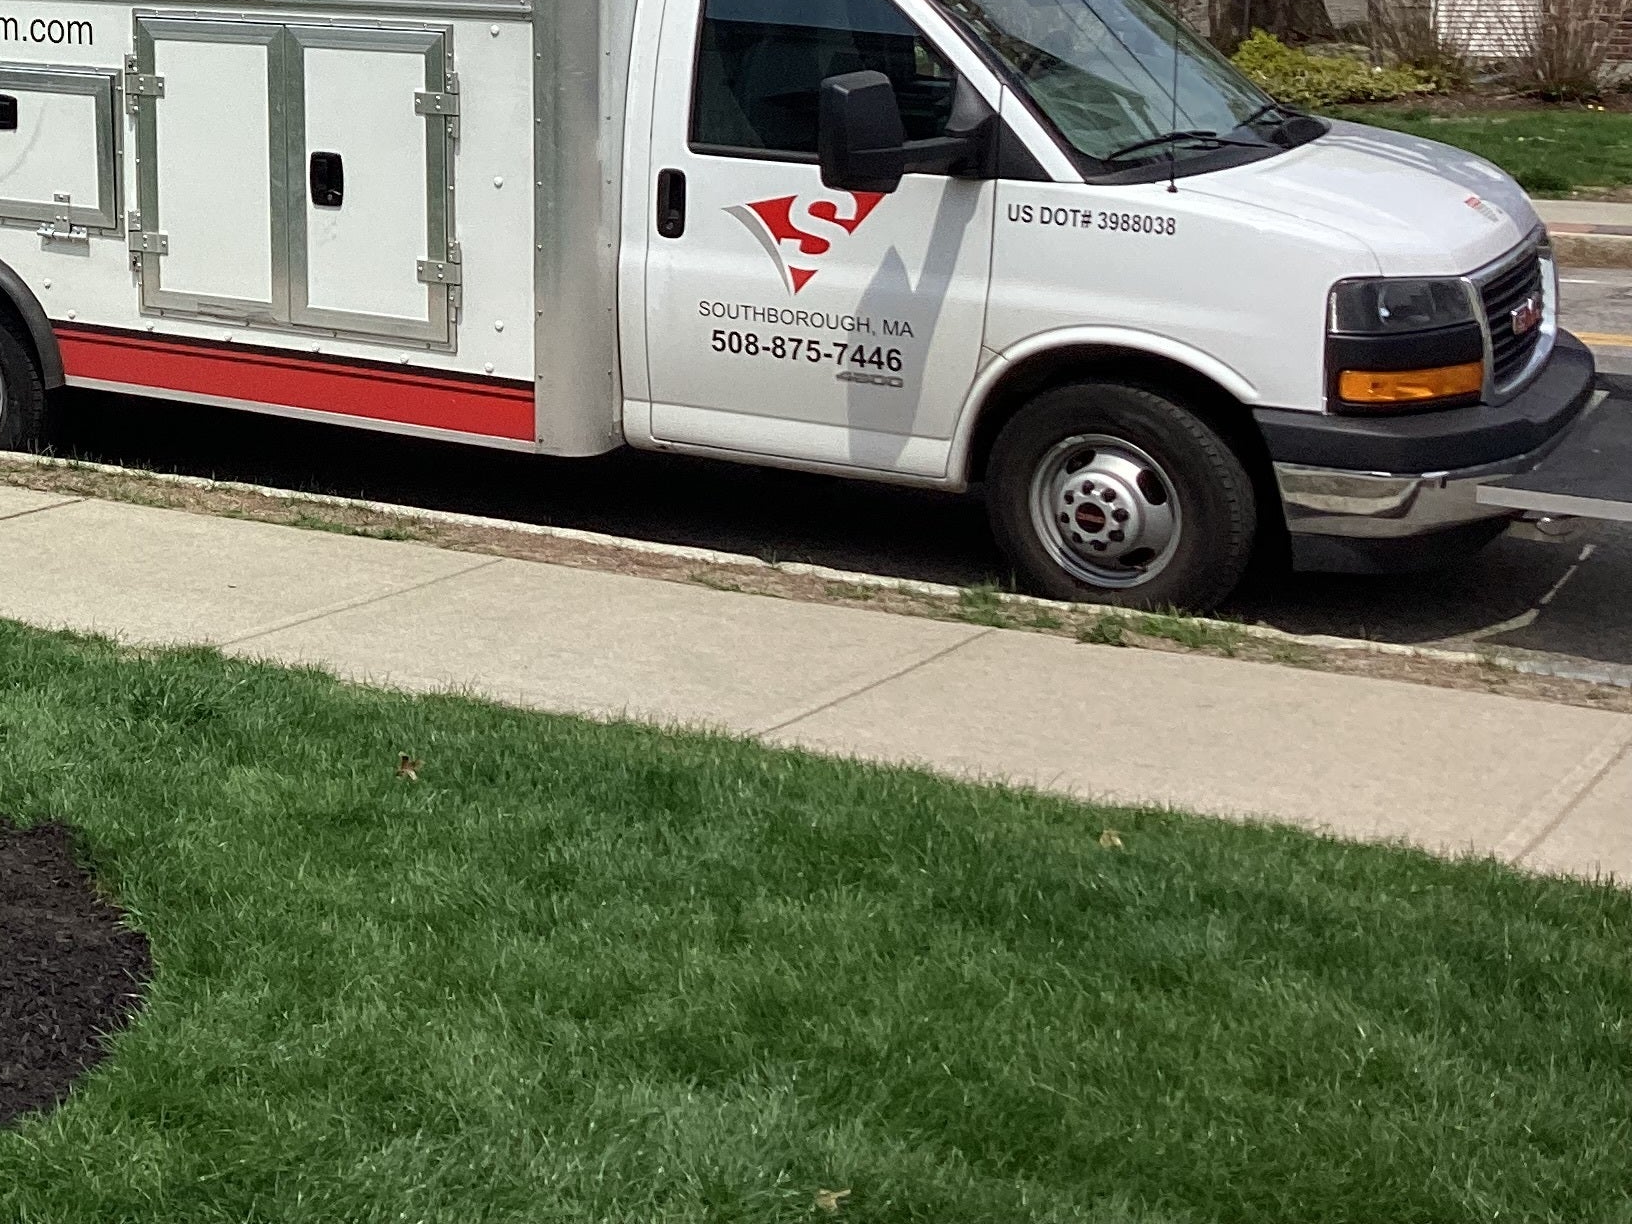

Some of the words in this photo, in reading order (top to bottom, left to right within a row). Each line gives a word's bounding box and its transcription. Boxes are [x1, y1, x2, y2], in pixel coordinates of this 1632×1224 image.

[1008, 203, 1033, 224] US
[1040, 206, 1092, 227] DOT#
[1097, 211, 1176, 236] 3988038
[698, 300, 878, 337] SOUTHBOROUGH,
[882, 319, 915, 338] MA
[711, 329, 903, 372] 508-875-7446
